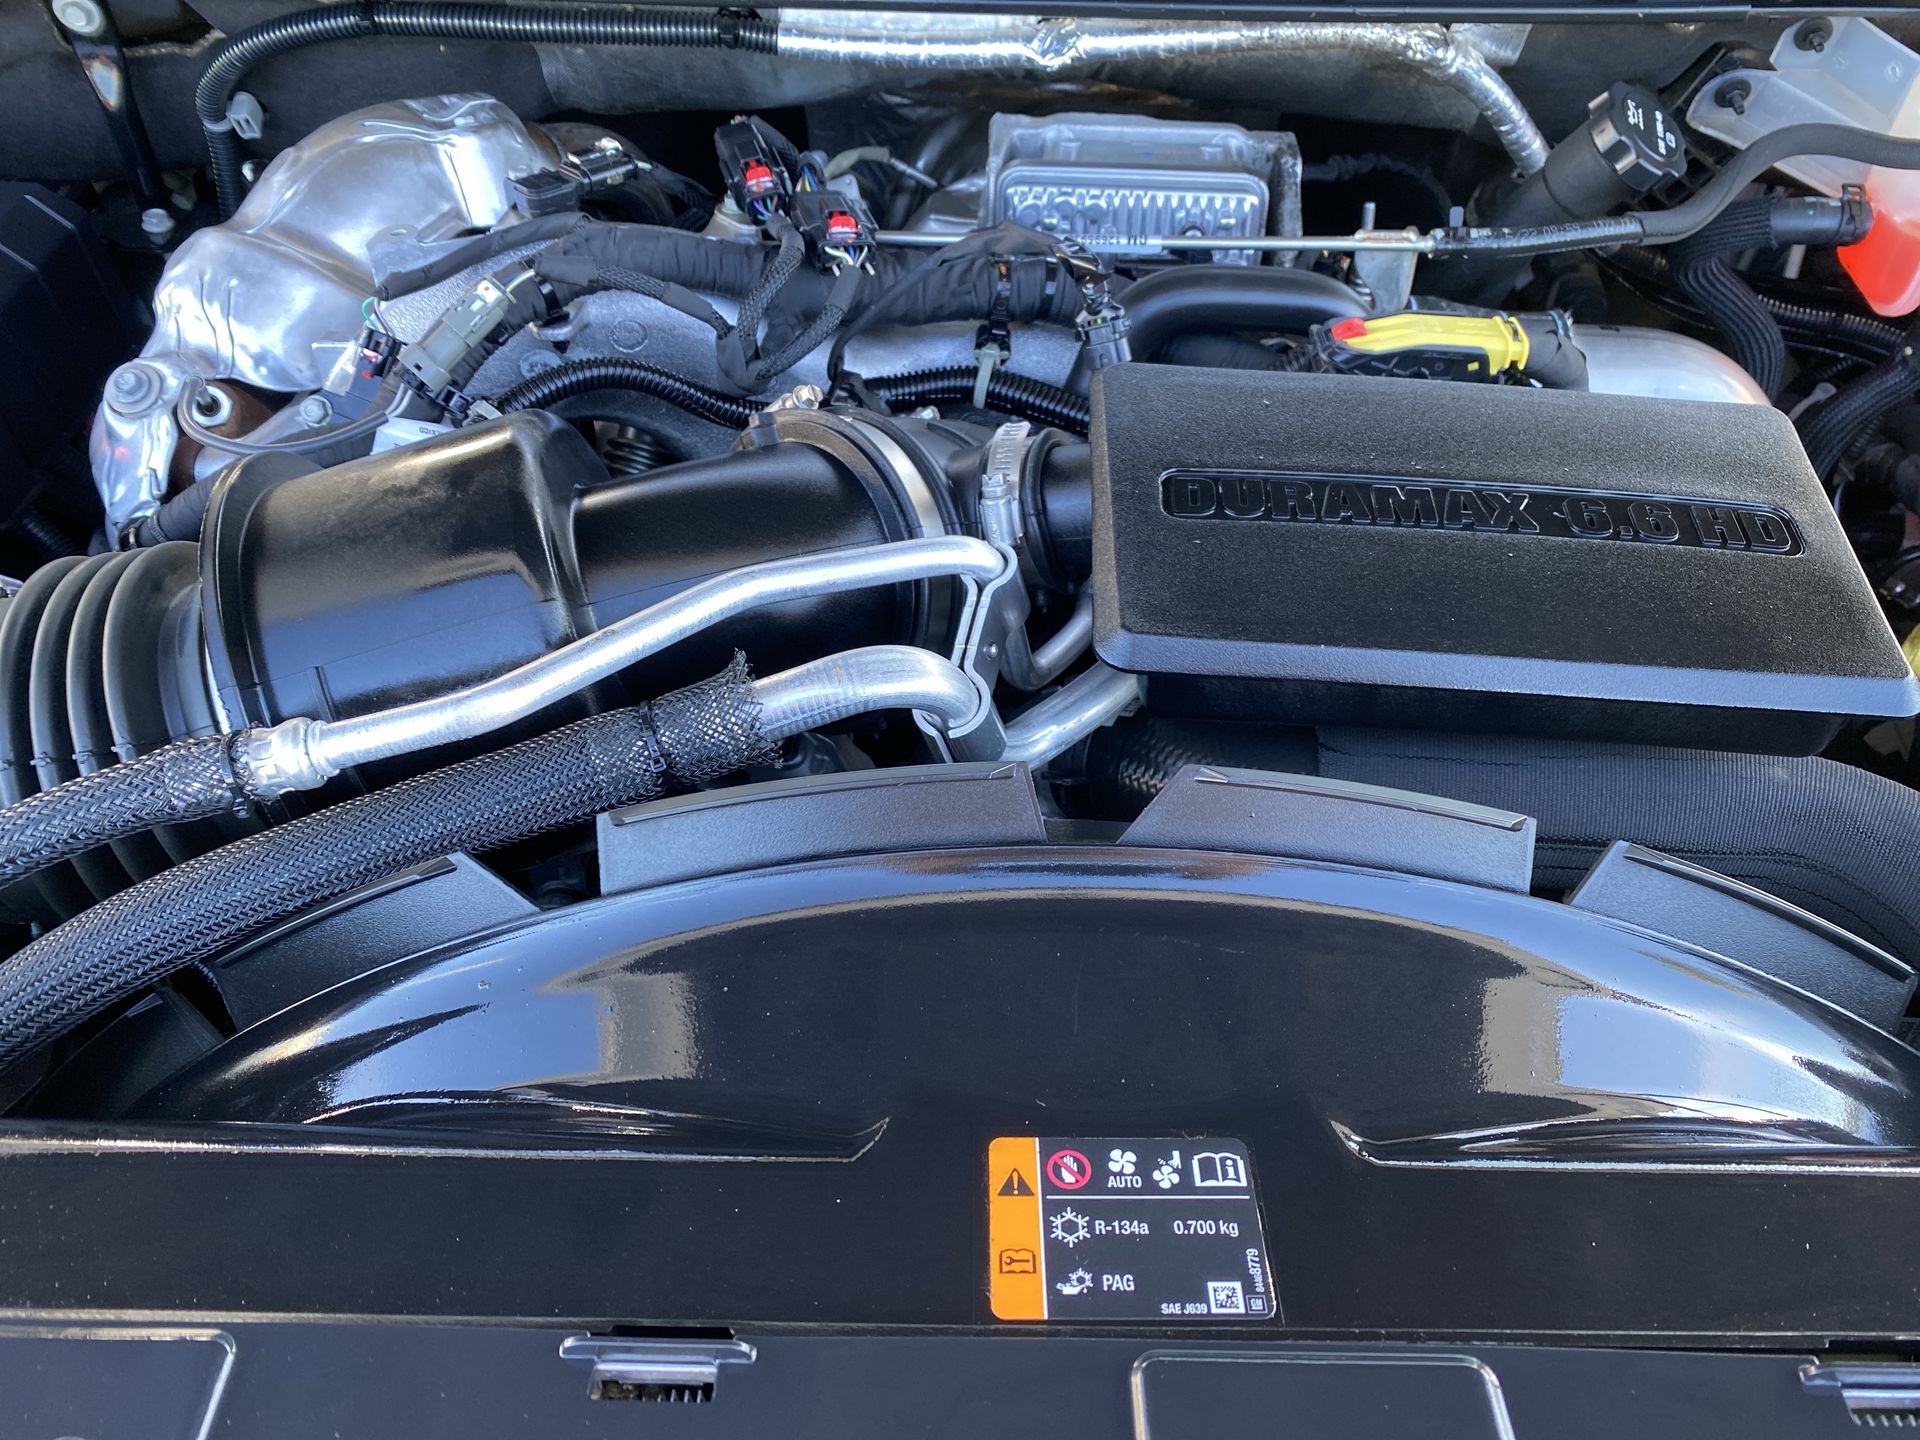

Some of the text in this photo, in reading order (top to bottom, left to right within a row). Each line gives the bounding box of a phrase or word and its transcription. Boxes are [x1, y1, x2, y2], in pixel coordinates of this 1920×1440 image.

[1171, 477, 1793, 553] DURAMAX 6.6 HD
[1107, 1176, 1142, 1188] AUTO
[1095, 1220, 1239, 1237] R-134a 0.700 kg
[1102, 1275, 1135, 1291] PAG
[1161, 1303, 1208, 1314] SAE J639
